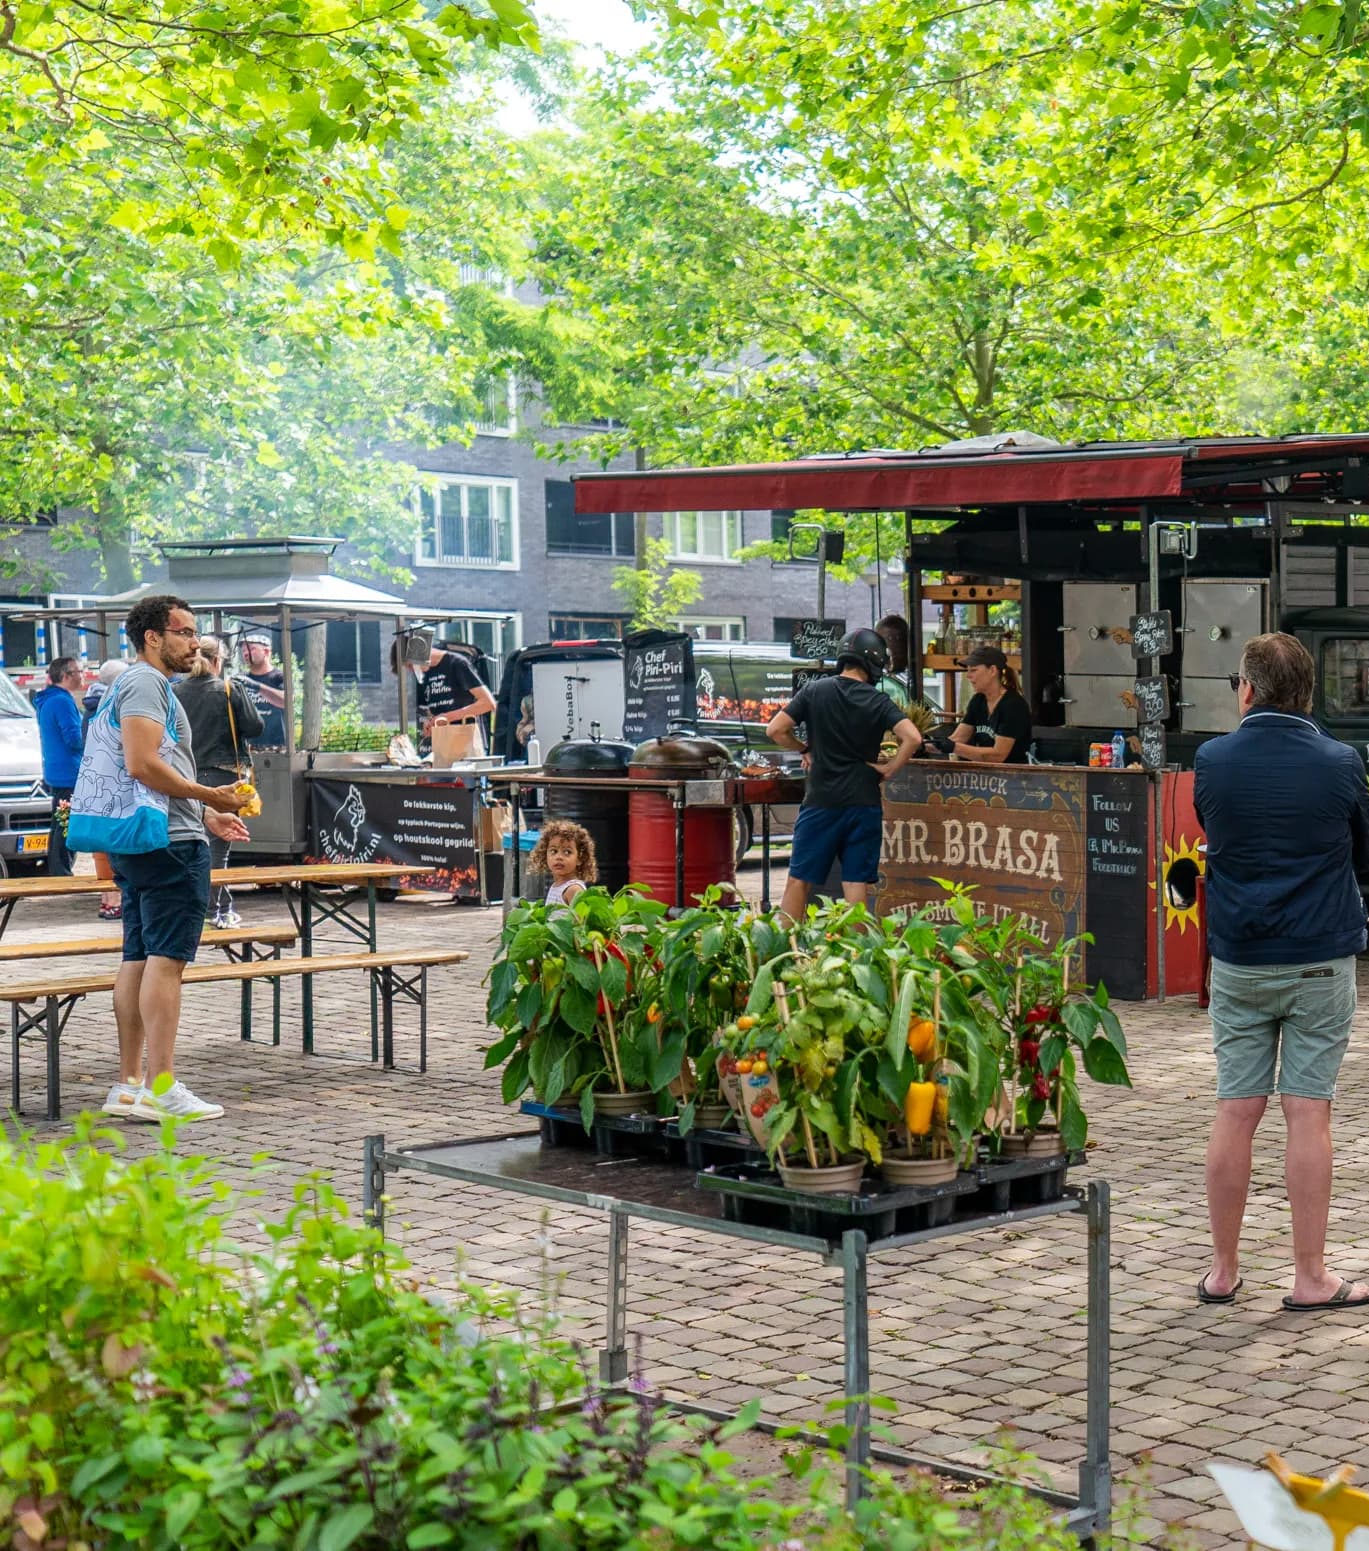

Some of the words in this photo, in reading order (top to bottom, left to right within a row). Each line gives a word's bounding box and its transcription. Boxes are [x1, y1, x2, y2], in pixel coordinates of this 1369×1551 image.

[645, 649, 666, 663] Chef
[645, 661, 684, 676] Piri-Piri
[926, 773, 1008, 796] FOODTRUCK
[403, 799, 412, 808] De
[1105, 817, 1120, 832] US
[393, 835, 403, 844] op
[404, 835, 443, 847] houtskool
[880, 818, 938, 865] MR.
[942, 819, 1064, 882] BRASA
